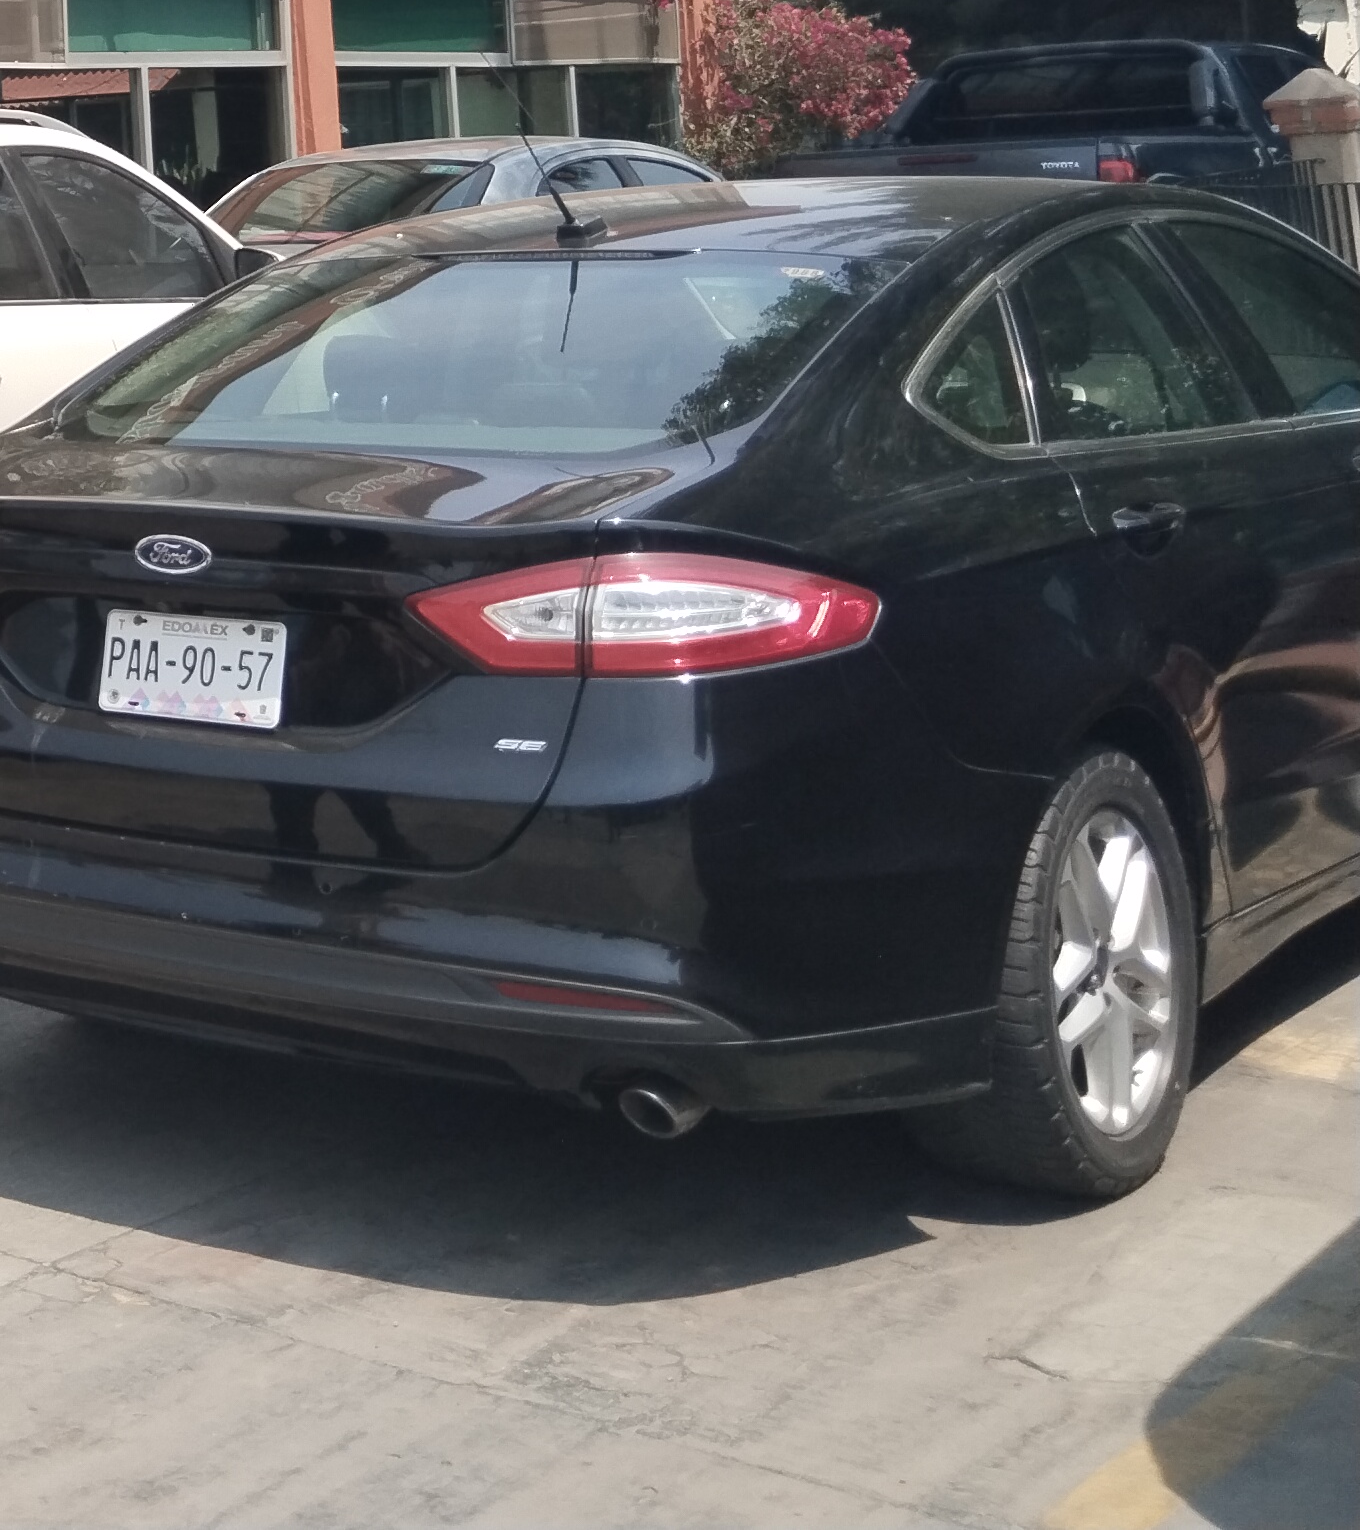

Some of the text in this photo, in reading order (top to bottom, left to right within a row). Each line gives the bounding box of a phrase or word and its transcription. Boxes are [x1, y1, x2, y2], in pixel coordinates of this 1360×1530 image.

[1040, 161, 1080, 170] TOYOTA
[149, 541, 192, 565] Ford
[108, 636, 273, 692] PAA-90-57
[493, 738, 547, 751] SE
